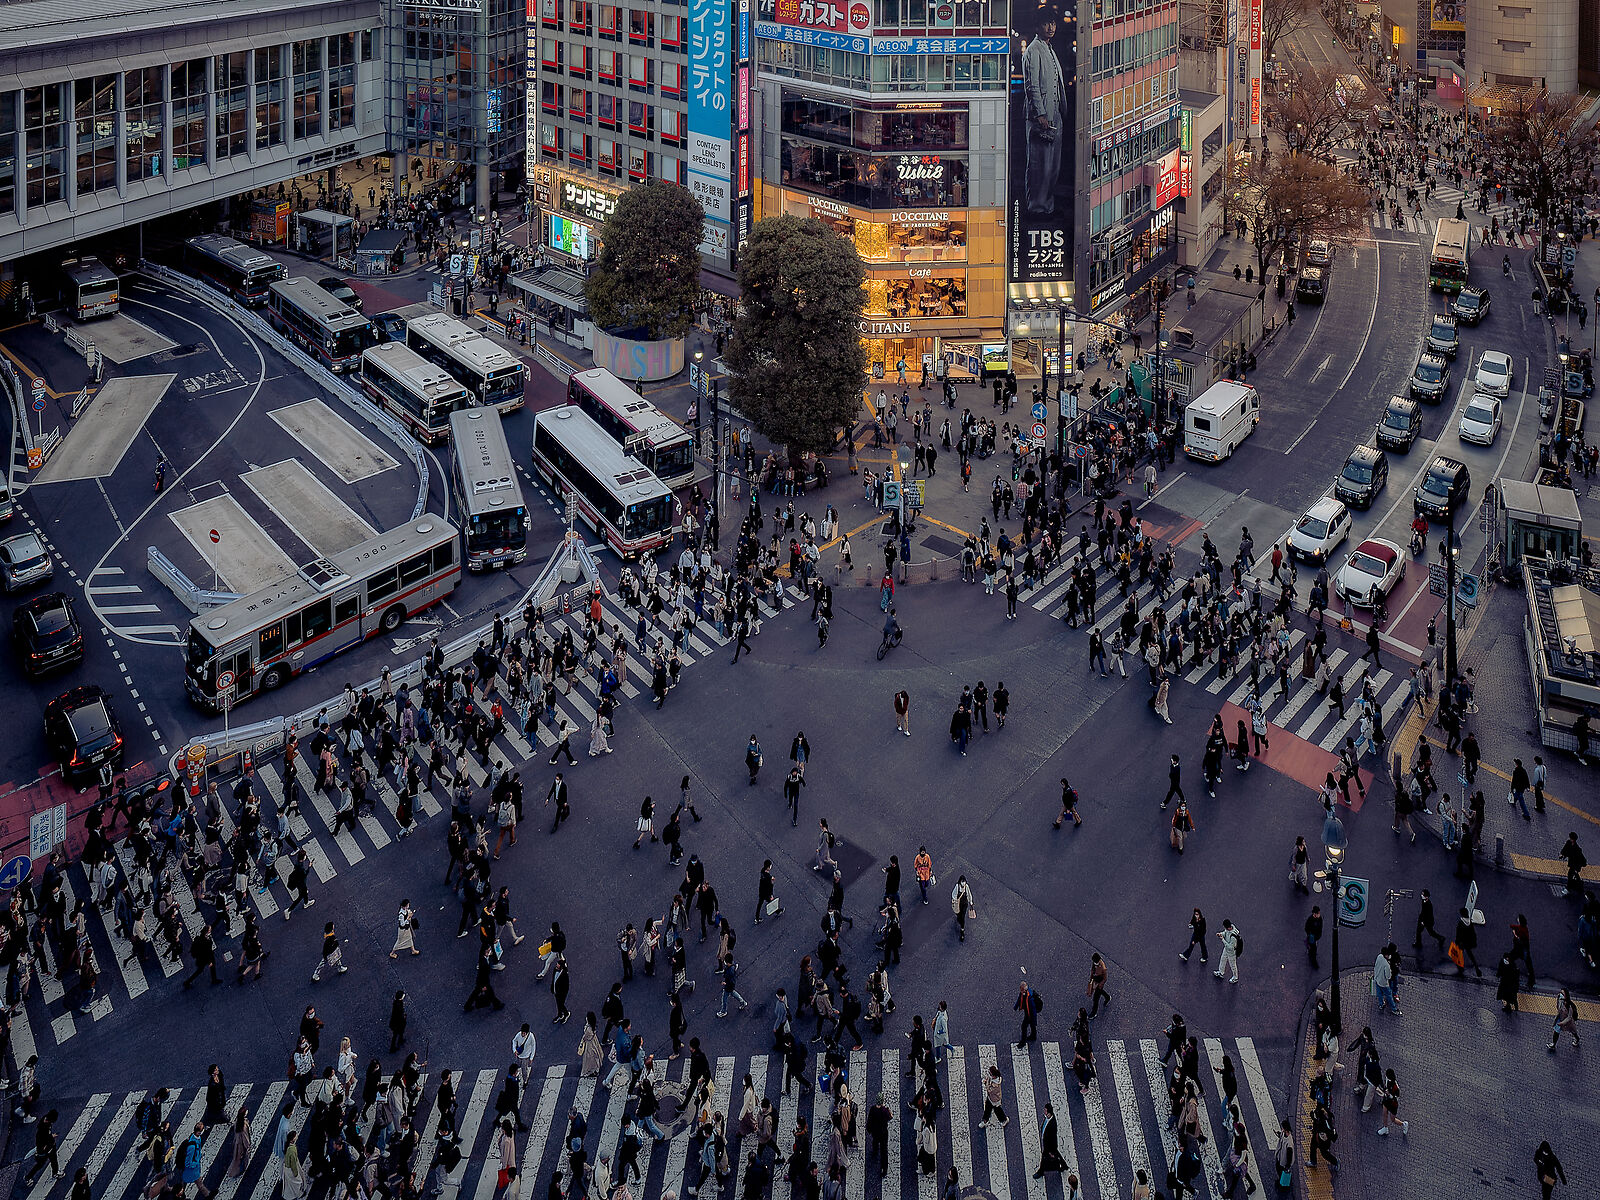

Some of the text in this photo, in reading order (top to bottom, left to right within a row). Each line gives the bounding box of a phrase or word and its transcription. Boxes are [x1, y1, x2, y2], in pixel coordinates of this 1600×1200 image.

[779, 0, 798, 11] Café
[799, 0, 844, 28] ガスト
[852, 13, 868, 22] ガスト
[1252, 5, 1260, 43] TaxFree
[757, 24, 779, 36] AEON
[784, 28, 849, 47] 英会話イーオン
[877, 40, 1007, 52] AEON 英会話イーオン
[696, 139, 722, 152] CONTACT
[692, 154, 726, 170] SPECIALISTS
[701, 150, 716, 159] LENS
[900, 155, 940, 164] 渋谷 焼肉
[897, 164, 944, 179] Ushi8
[565, 183, 619, 214] サンドラッ
[808, 196, 849, 214] L'OCCITANE
[892, 212, 949, 222] L'OCCITANE
[1150, 205, 1173, 234] LUSH
[1028, 230, 1064, 247] TBS
[1028, 248, 1064, 263] ラジオ
[1100, 278, 1125, 302] サンドラッグ
